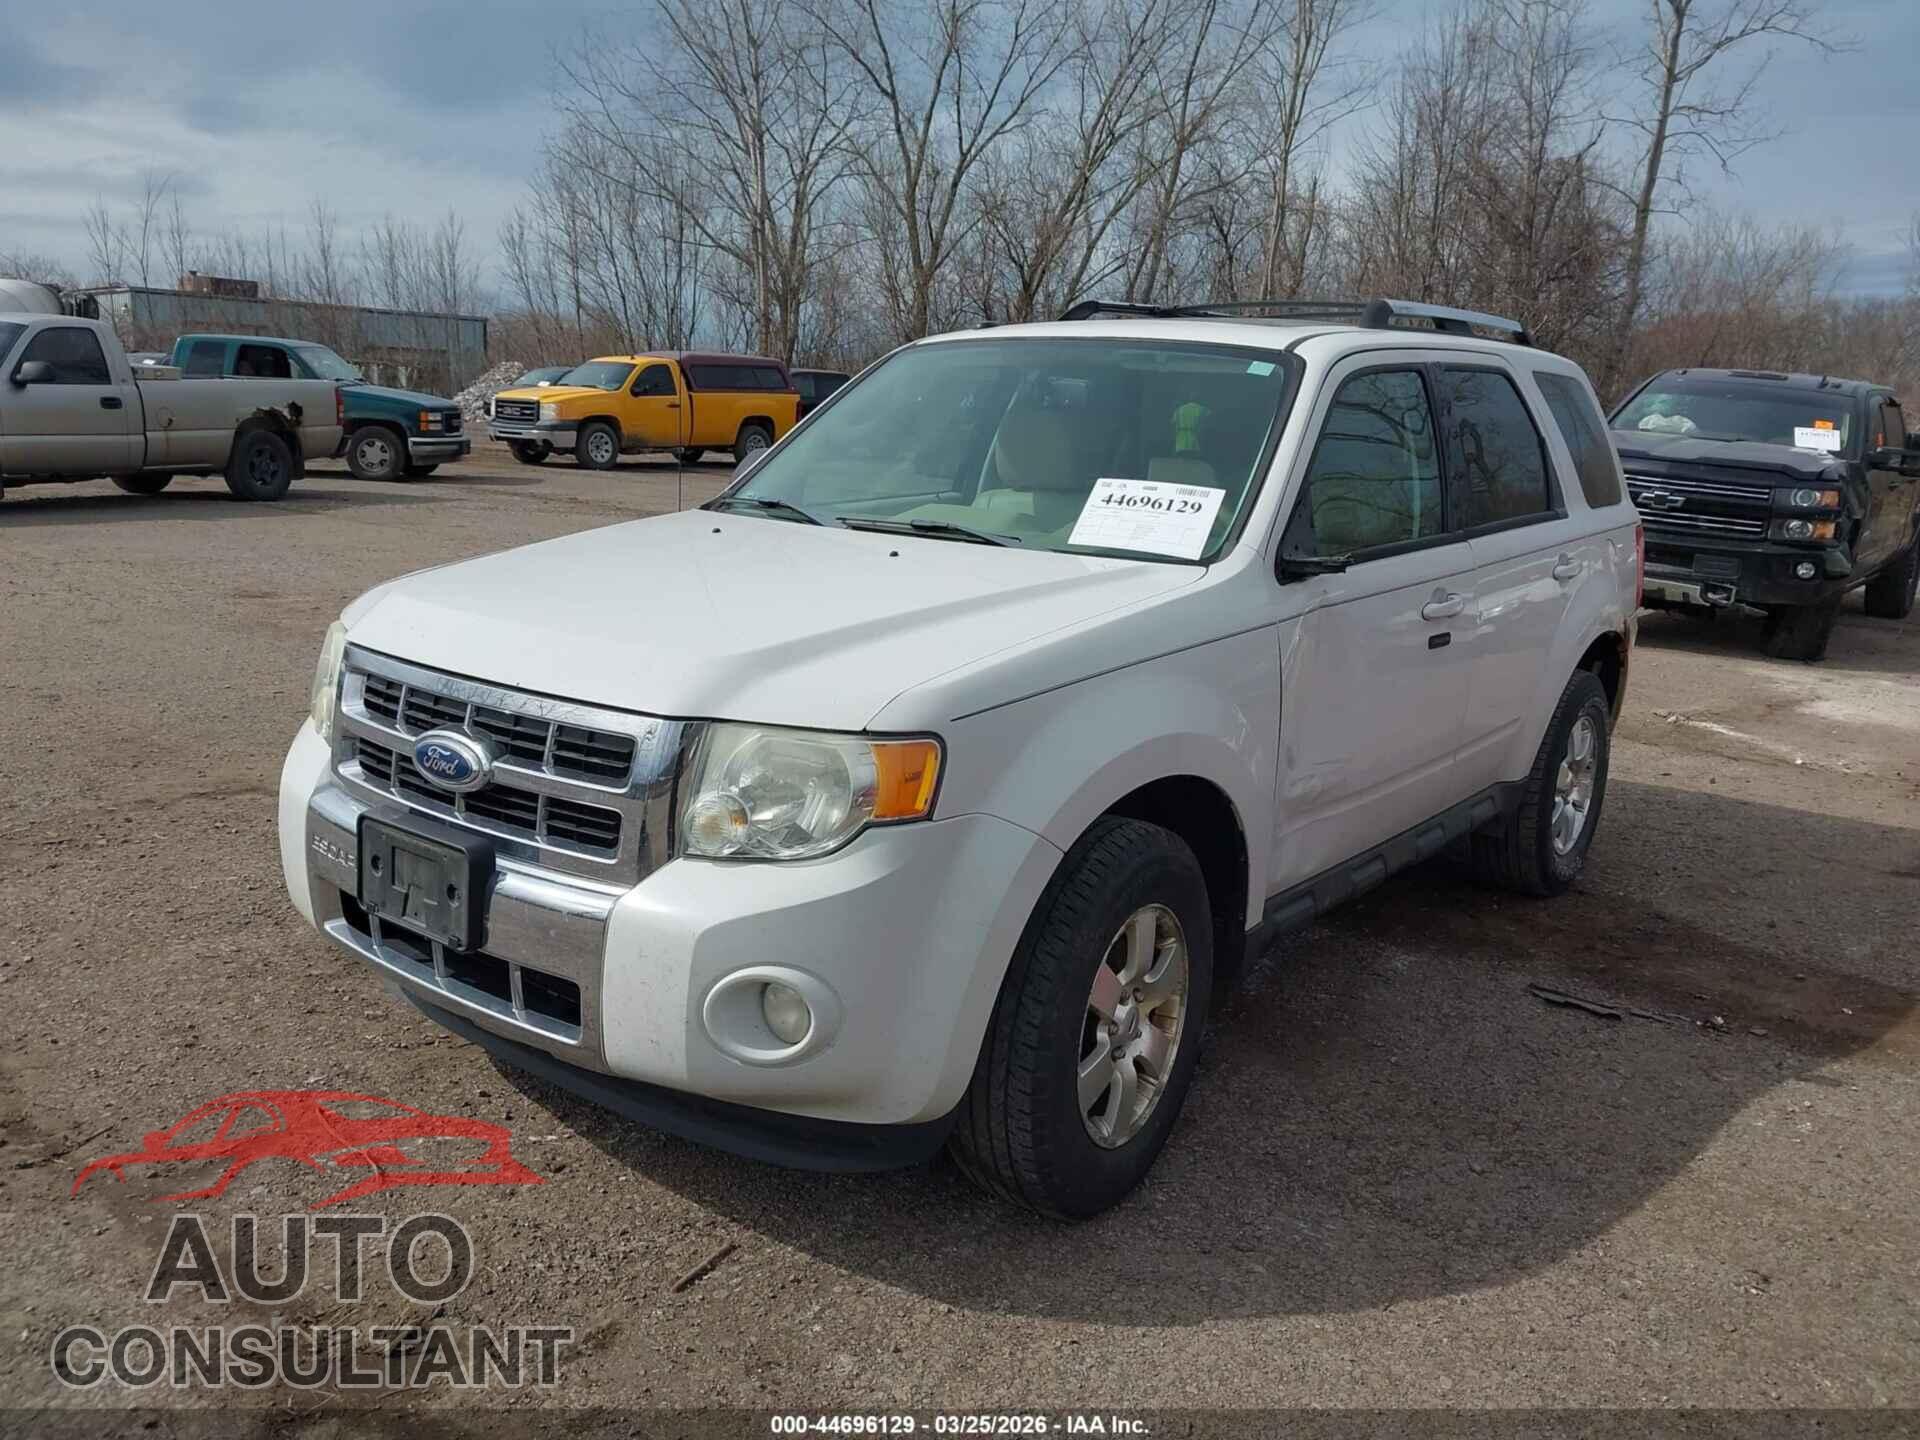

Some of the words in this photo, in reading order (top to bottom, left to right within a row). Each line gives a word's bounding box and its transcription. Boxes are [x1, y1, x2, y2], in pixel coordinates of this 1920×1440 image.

[1101, 493, 1203, 514] 44696129
[424, 745, 458, 775] Ford
[311, 835, 357, 872] ESCAP
